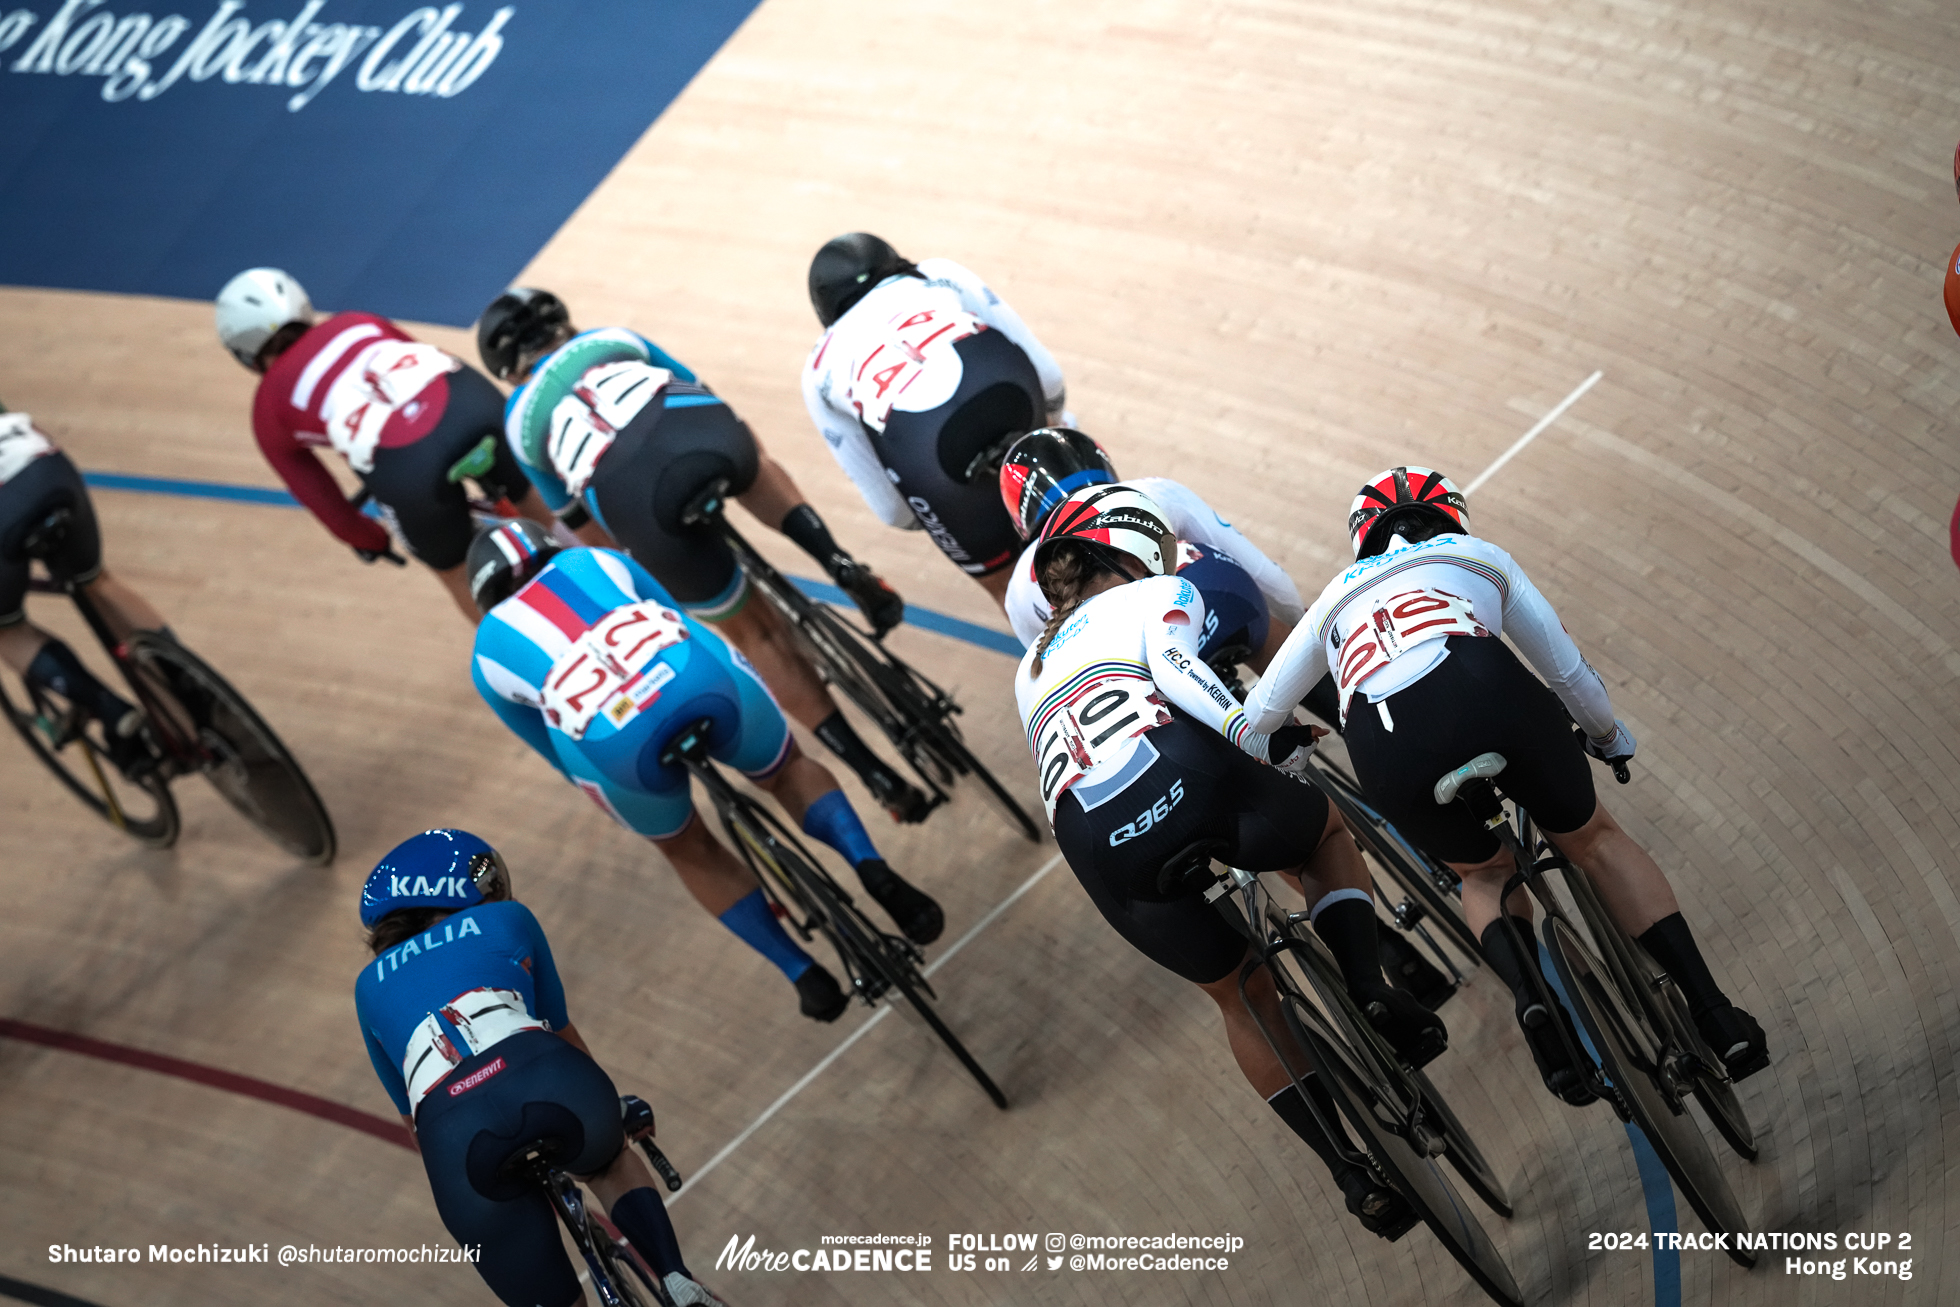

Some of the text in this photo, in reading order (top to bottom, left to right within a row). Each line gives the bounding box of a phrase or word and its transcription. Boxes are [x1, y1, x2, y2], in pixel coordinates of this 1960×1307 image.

[9, 0, 191, 102] Kong
[137, 0, 381, 112] Jockey
[355, 2, 515, 97] Club
[1096, 514, 1163, 535] Kabuto
[1187, 669, 1204, 686] Powered
[1206, 684, 1232, 711] KEIRIN
[1079, 690, 1140, 749] 10
[1109, 778, 1185, 847] Q36.5
[391, 876, 467, 898] KASK
[376, 916, 482, 982] ITALIA
[464, 1058, 502, 1089] ENERVIT
